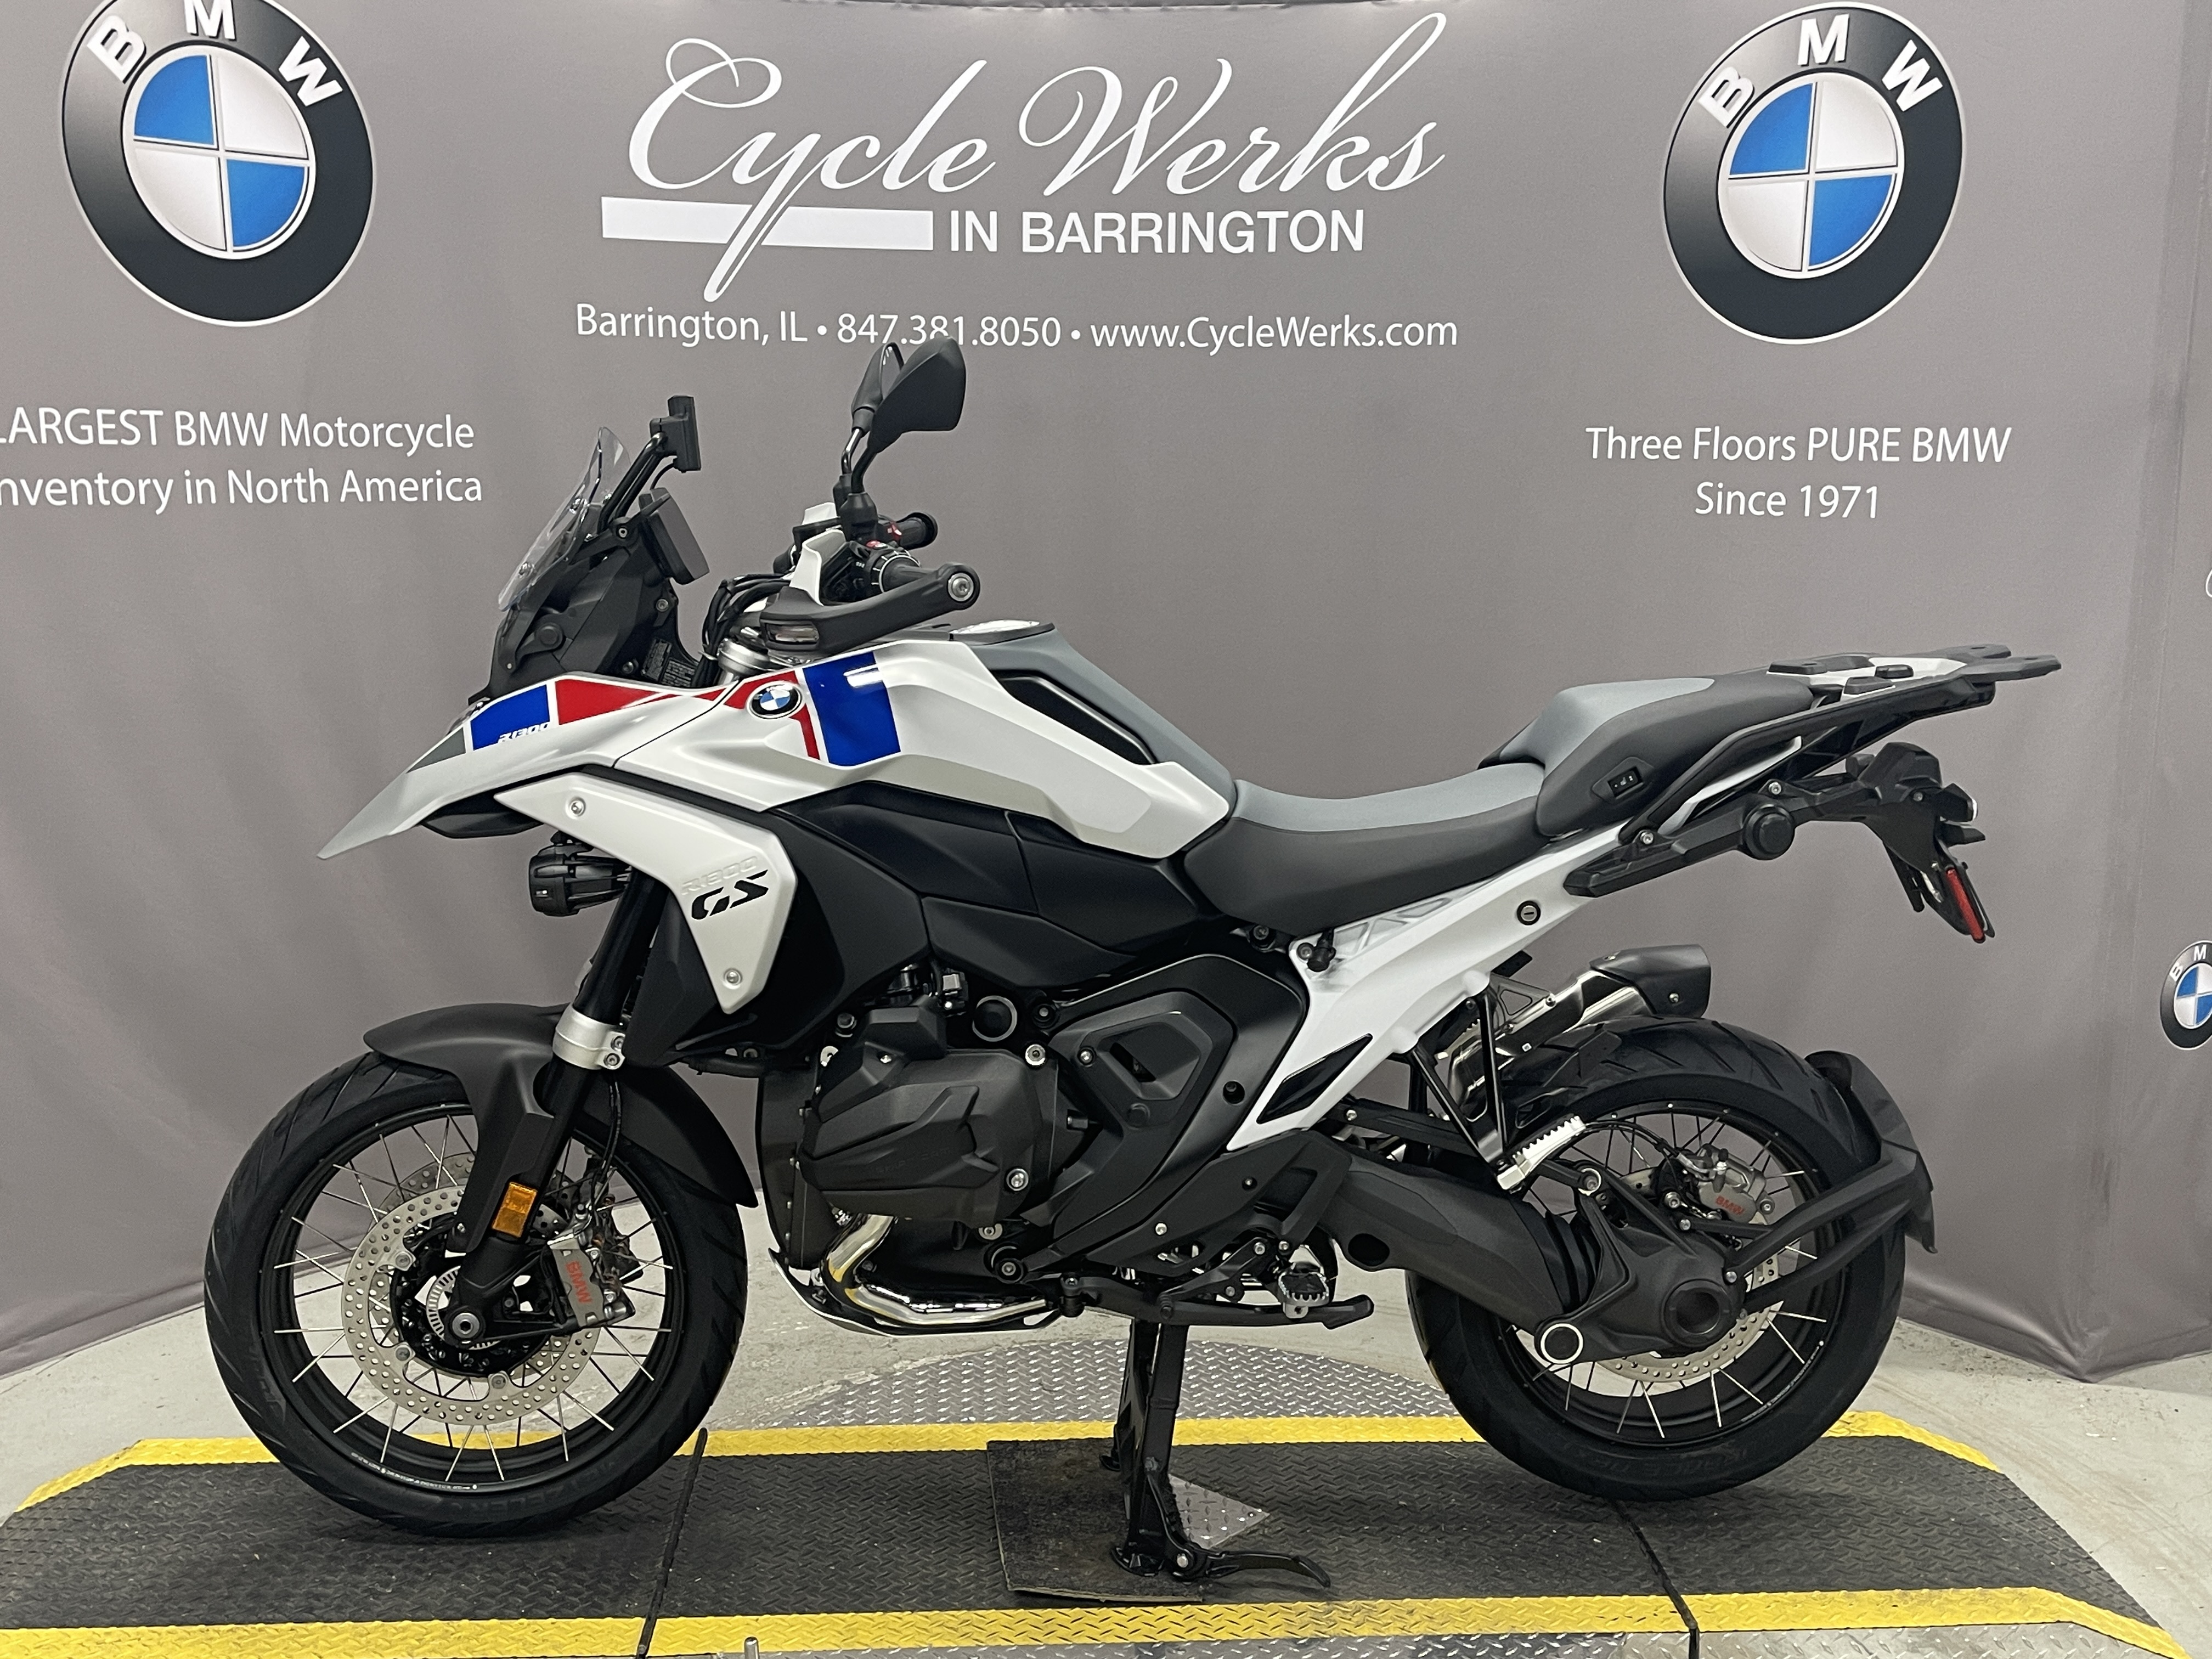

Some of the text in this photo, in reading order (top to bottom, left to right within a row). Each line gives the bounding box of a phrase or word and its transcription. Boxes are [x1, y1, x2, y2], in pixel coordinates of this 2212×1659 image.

[88, 0, 343, 107] BMW
[1698, 14, 1944, 127] BMW
[628, 12, 1447, 303] Cycle Werks
[950, 208, 1364, 254] IN BARRINGTON
[576, 303, 1458, 357] Barrington, IL 847.381.8050 www.CycleWerks.com
[0, 407, 475, 458] ARGEST BMW Motorcycle
[1585, 425, 2013, 463] Three Floors PURE BMW
[0, 467, 482, 516] nventory in North America
[1695, 481, 1879, 519] Since 1971
[691, 869, 769, 921] GS
[565, 1260, 593, 1304] BMW
